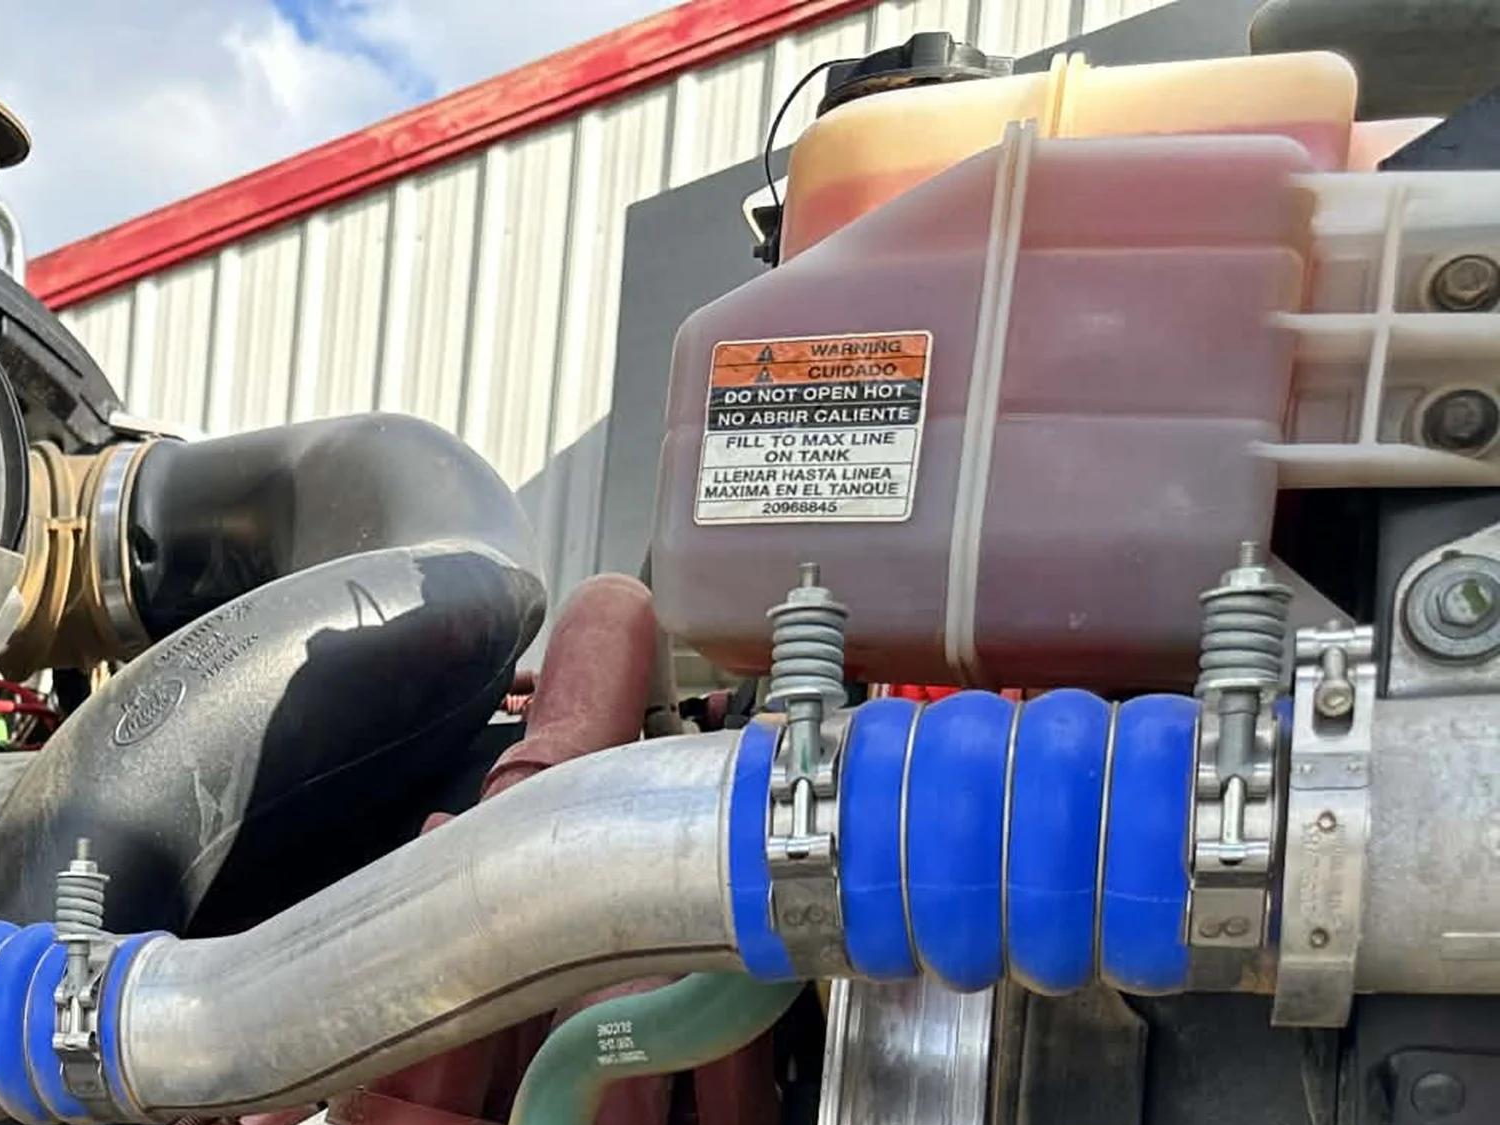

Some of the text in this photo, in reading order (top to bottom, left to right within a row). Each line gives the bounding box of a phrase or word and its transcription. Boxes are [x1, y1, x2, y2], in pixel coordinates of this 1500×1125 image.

[810, 340, 902, 357] WARNING
[808, 363, 898, 379] CUIDADO
[724, 383, 906, 405] DO NOT OPEN HOT
[717, 407, 910, 427] NO ABRIR CALIENTE
[726, 431, 896, 449] FILL TO MAX LINE
[764, 449, 850, 463] ON TANK
[713, 467, 892, 483] LLENAR HASTA LINEA
[704, 482, 899, 499] MAXIMA EN EL TANQUE
